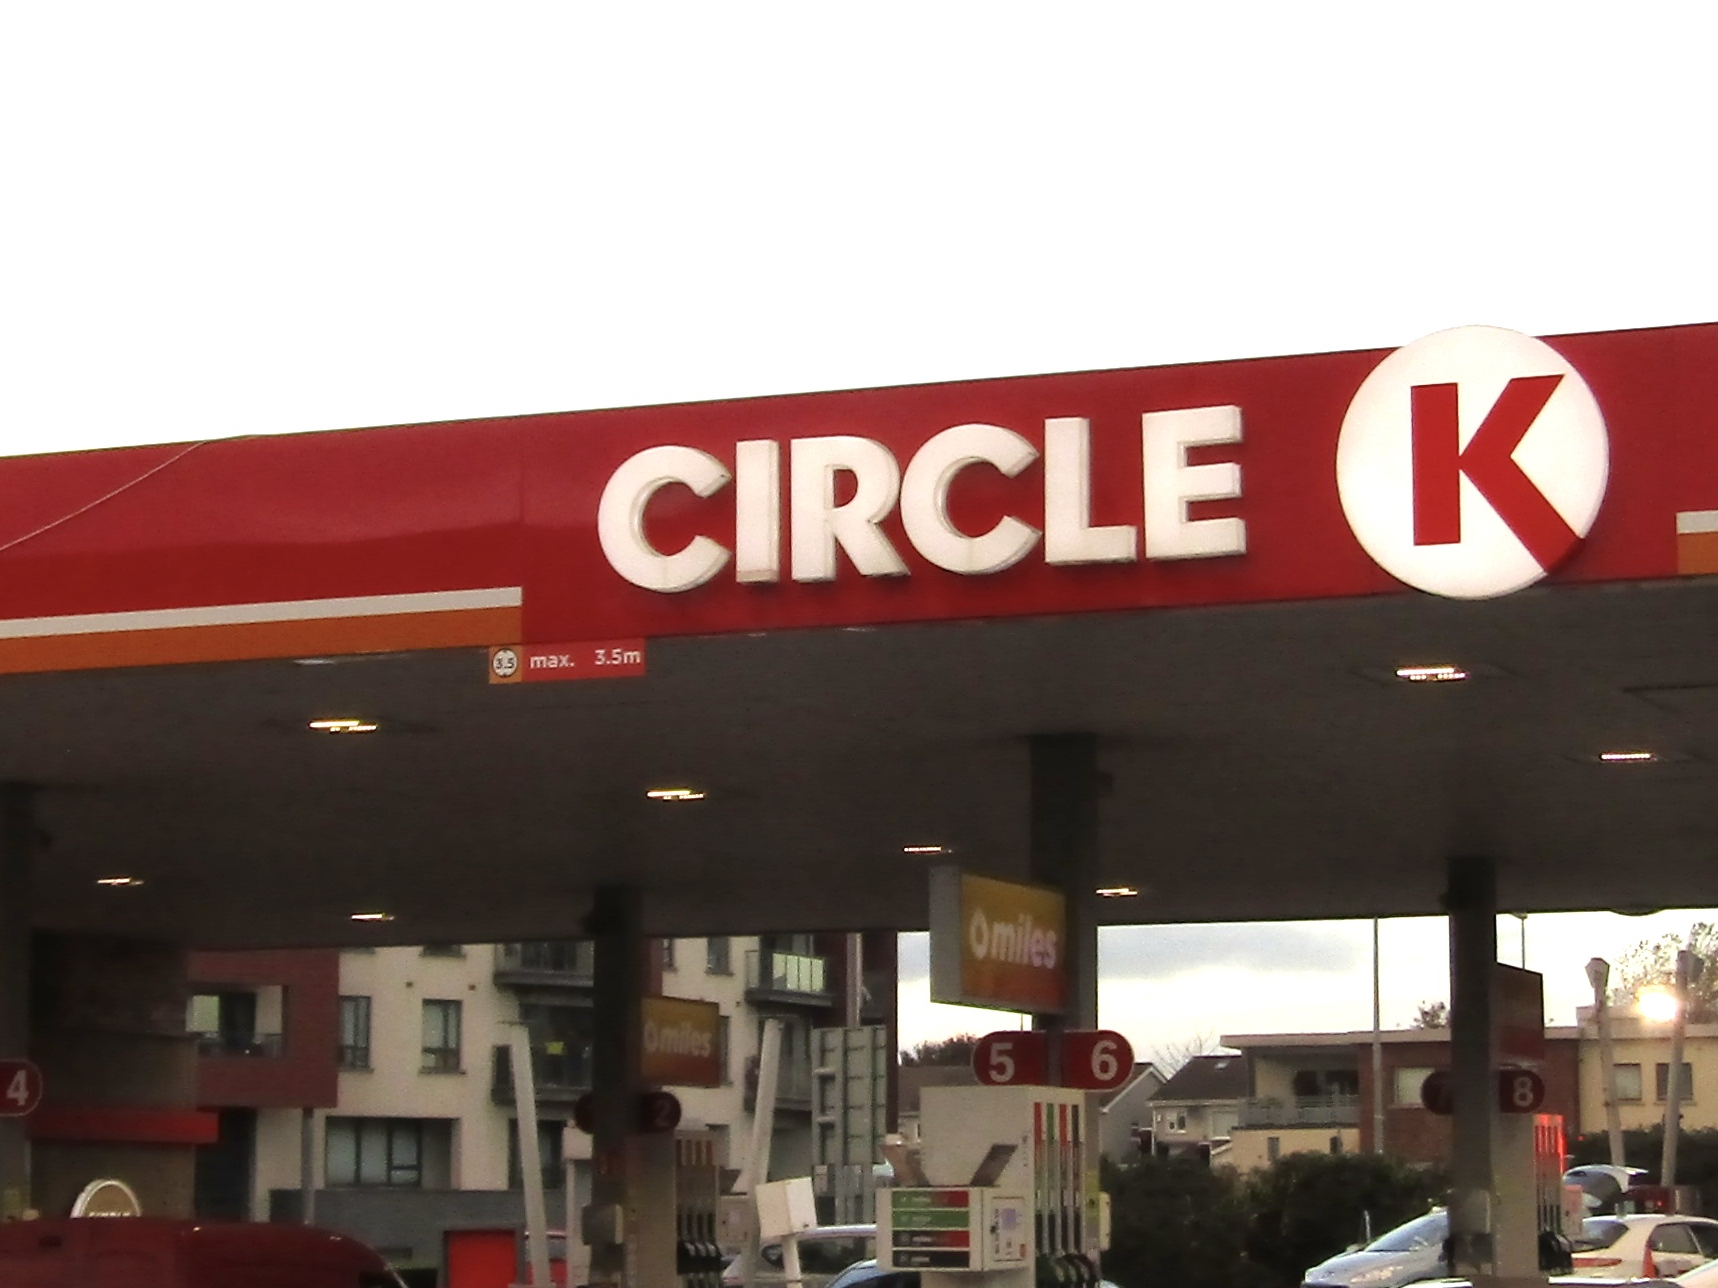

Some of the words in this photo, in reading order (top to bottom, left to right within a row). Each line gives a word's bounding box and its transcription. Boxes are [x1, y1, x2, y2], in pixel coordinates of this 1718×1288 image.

[596, 404, 1246, 593] CIRCLE
[1410, 372, 1586, 576] K
[529, 653, 575, 670] max.
[594, 648, 641, 665] 3.5m
[988, 1041, 1015, 1083] 5
[1090, 1038, 1118, 1082] 6
[6, 1069, 30, 1107] 4
[1512, 1076, 1534, 1108] 8
